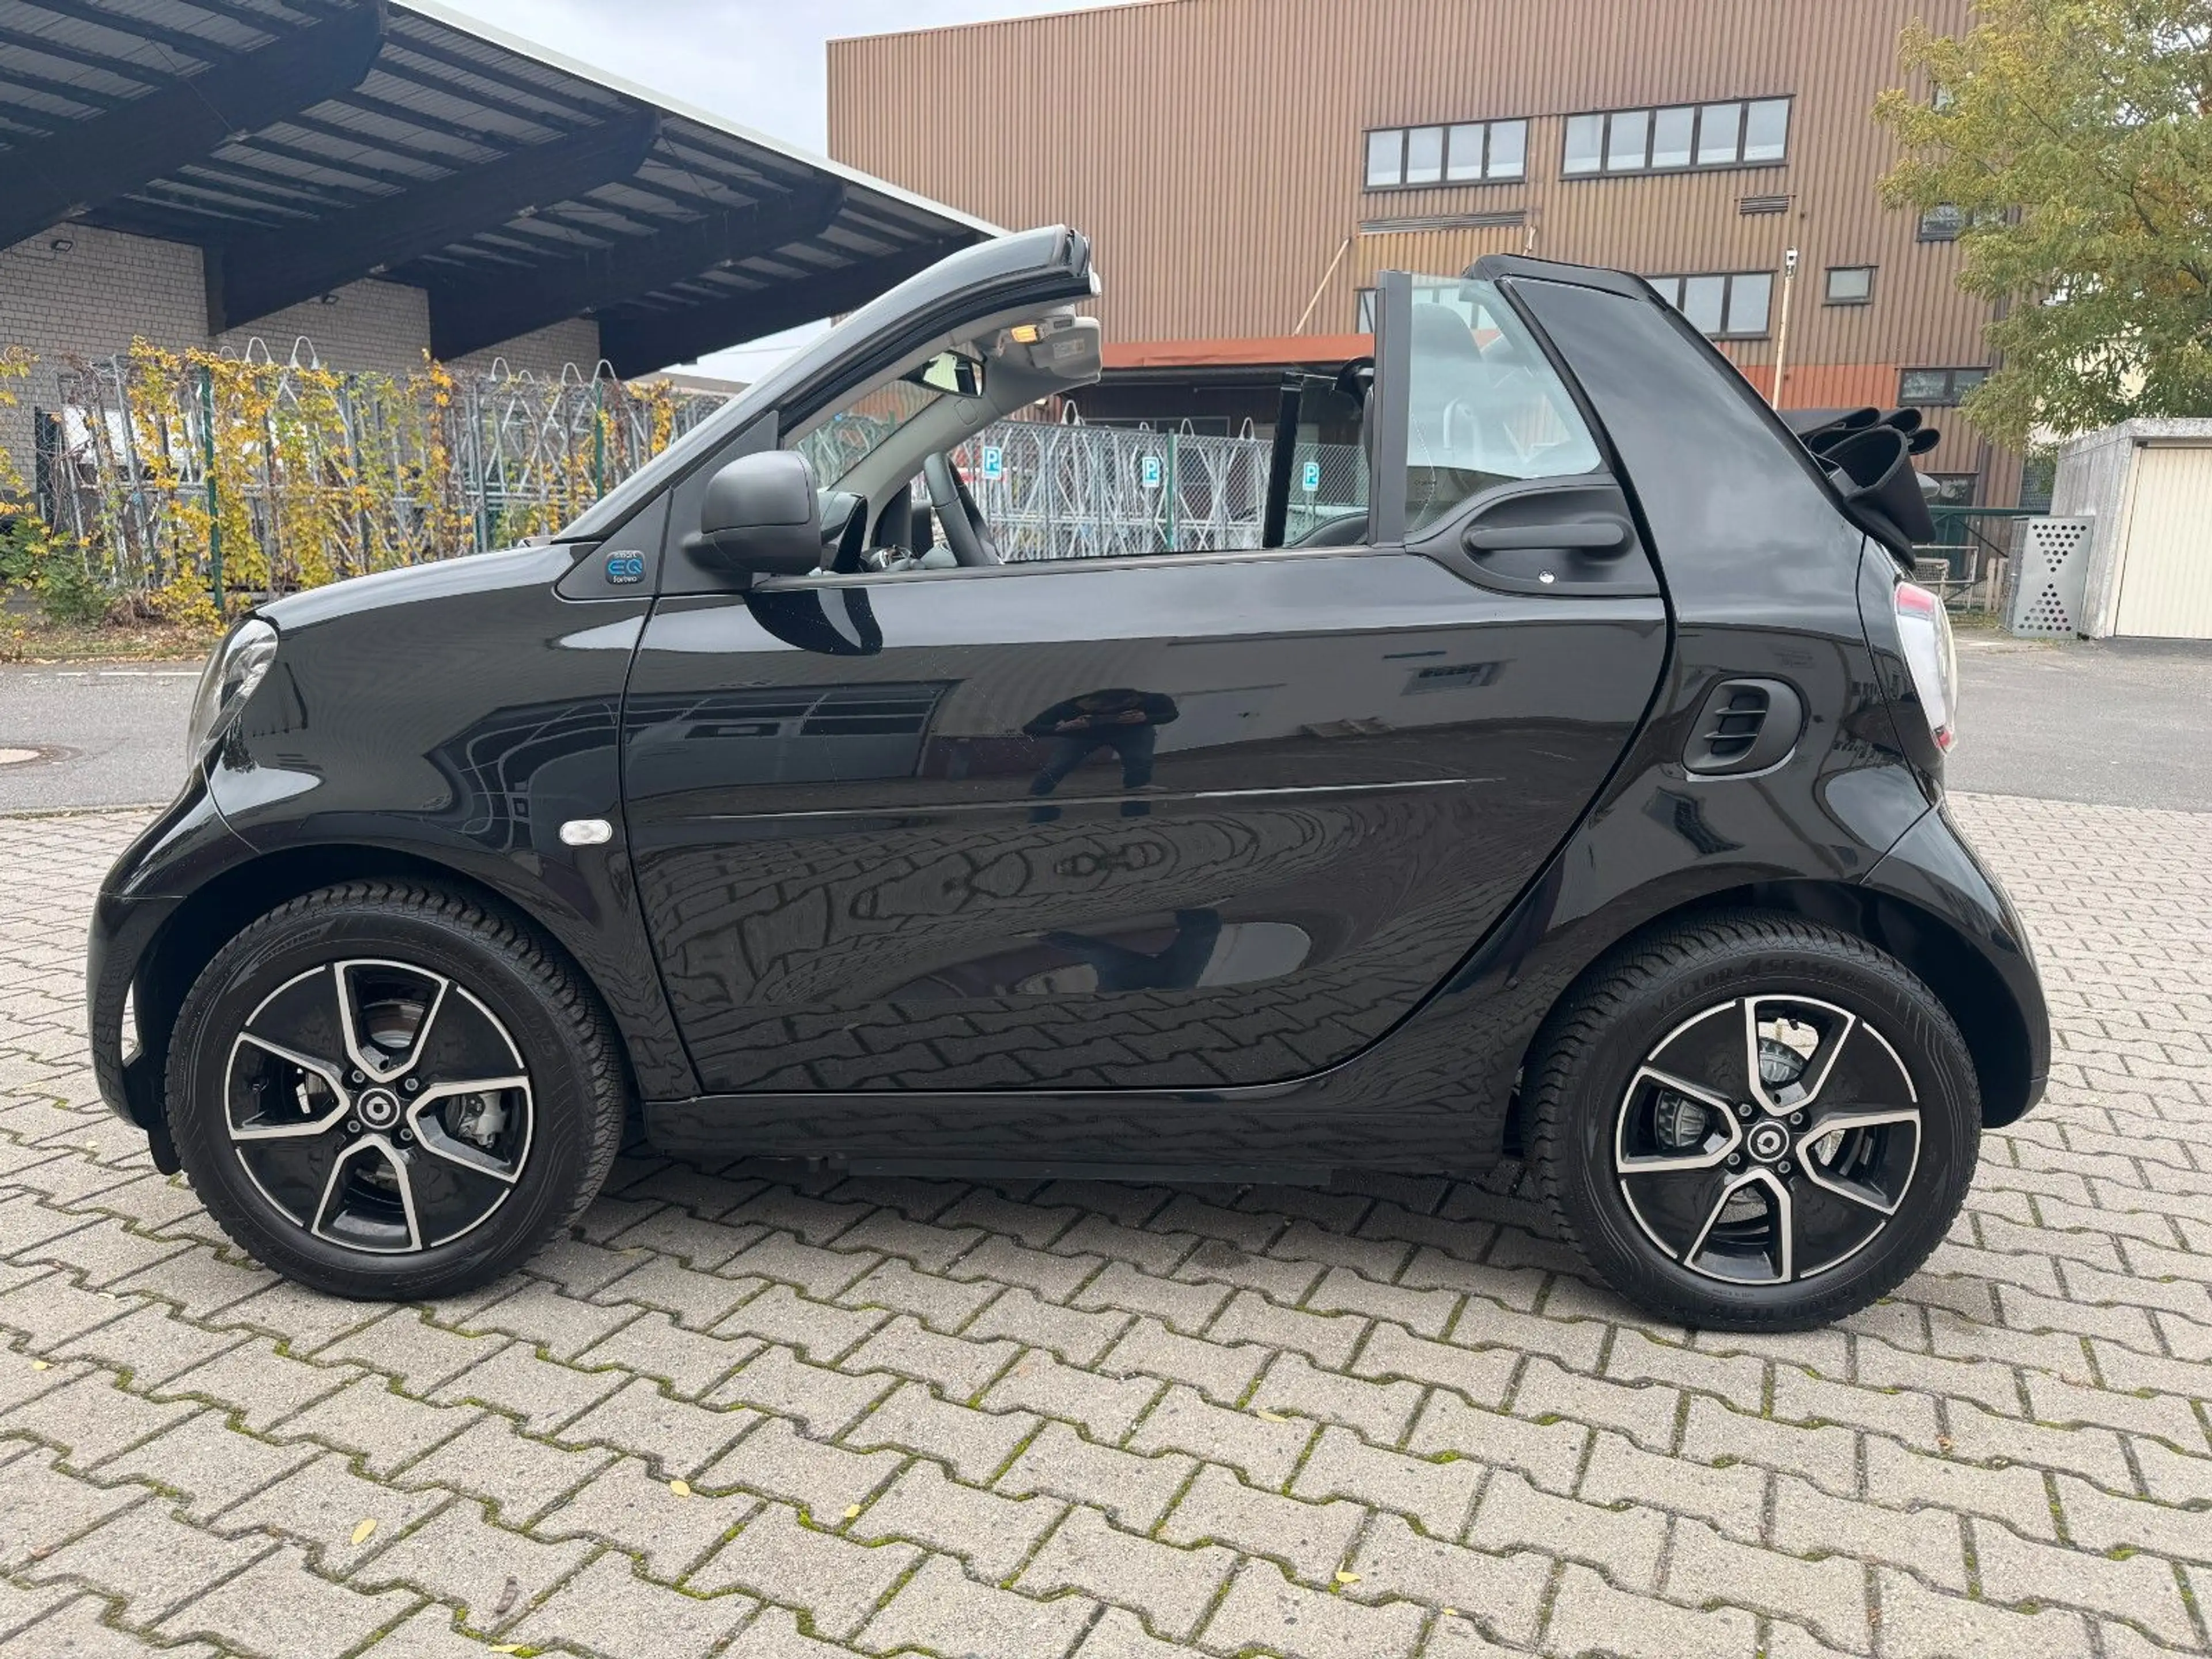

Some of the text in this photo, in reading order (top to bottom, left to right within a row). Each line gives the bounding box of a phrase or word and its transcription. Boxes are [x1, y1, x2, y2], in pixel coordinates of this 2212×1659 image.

[986, 450, 998, 469] P
[1146, 460, 1157, 478] P
[1306, 466, 1316, 482] P
[608, 559, 642, 575] EQ
